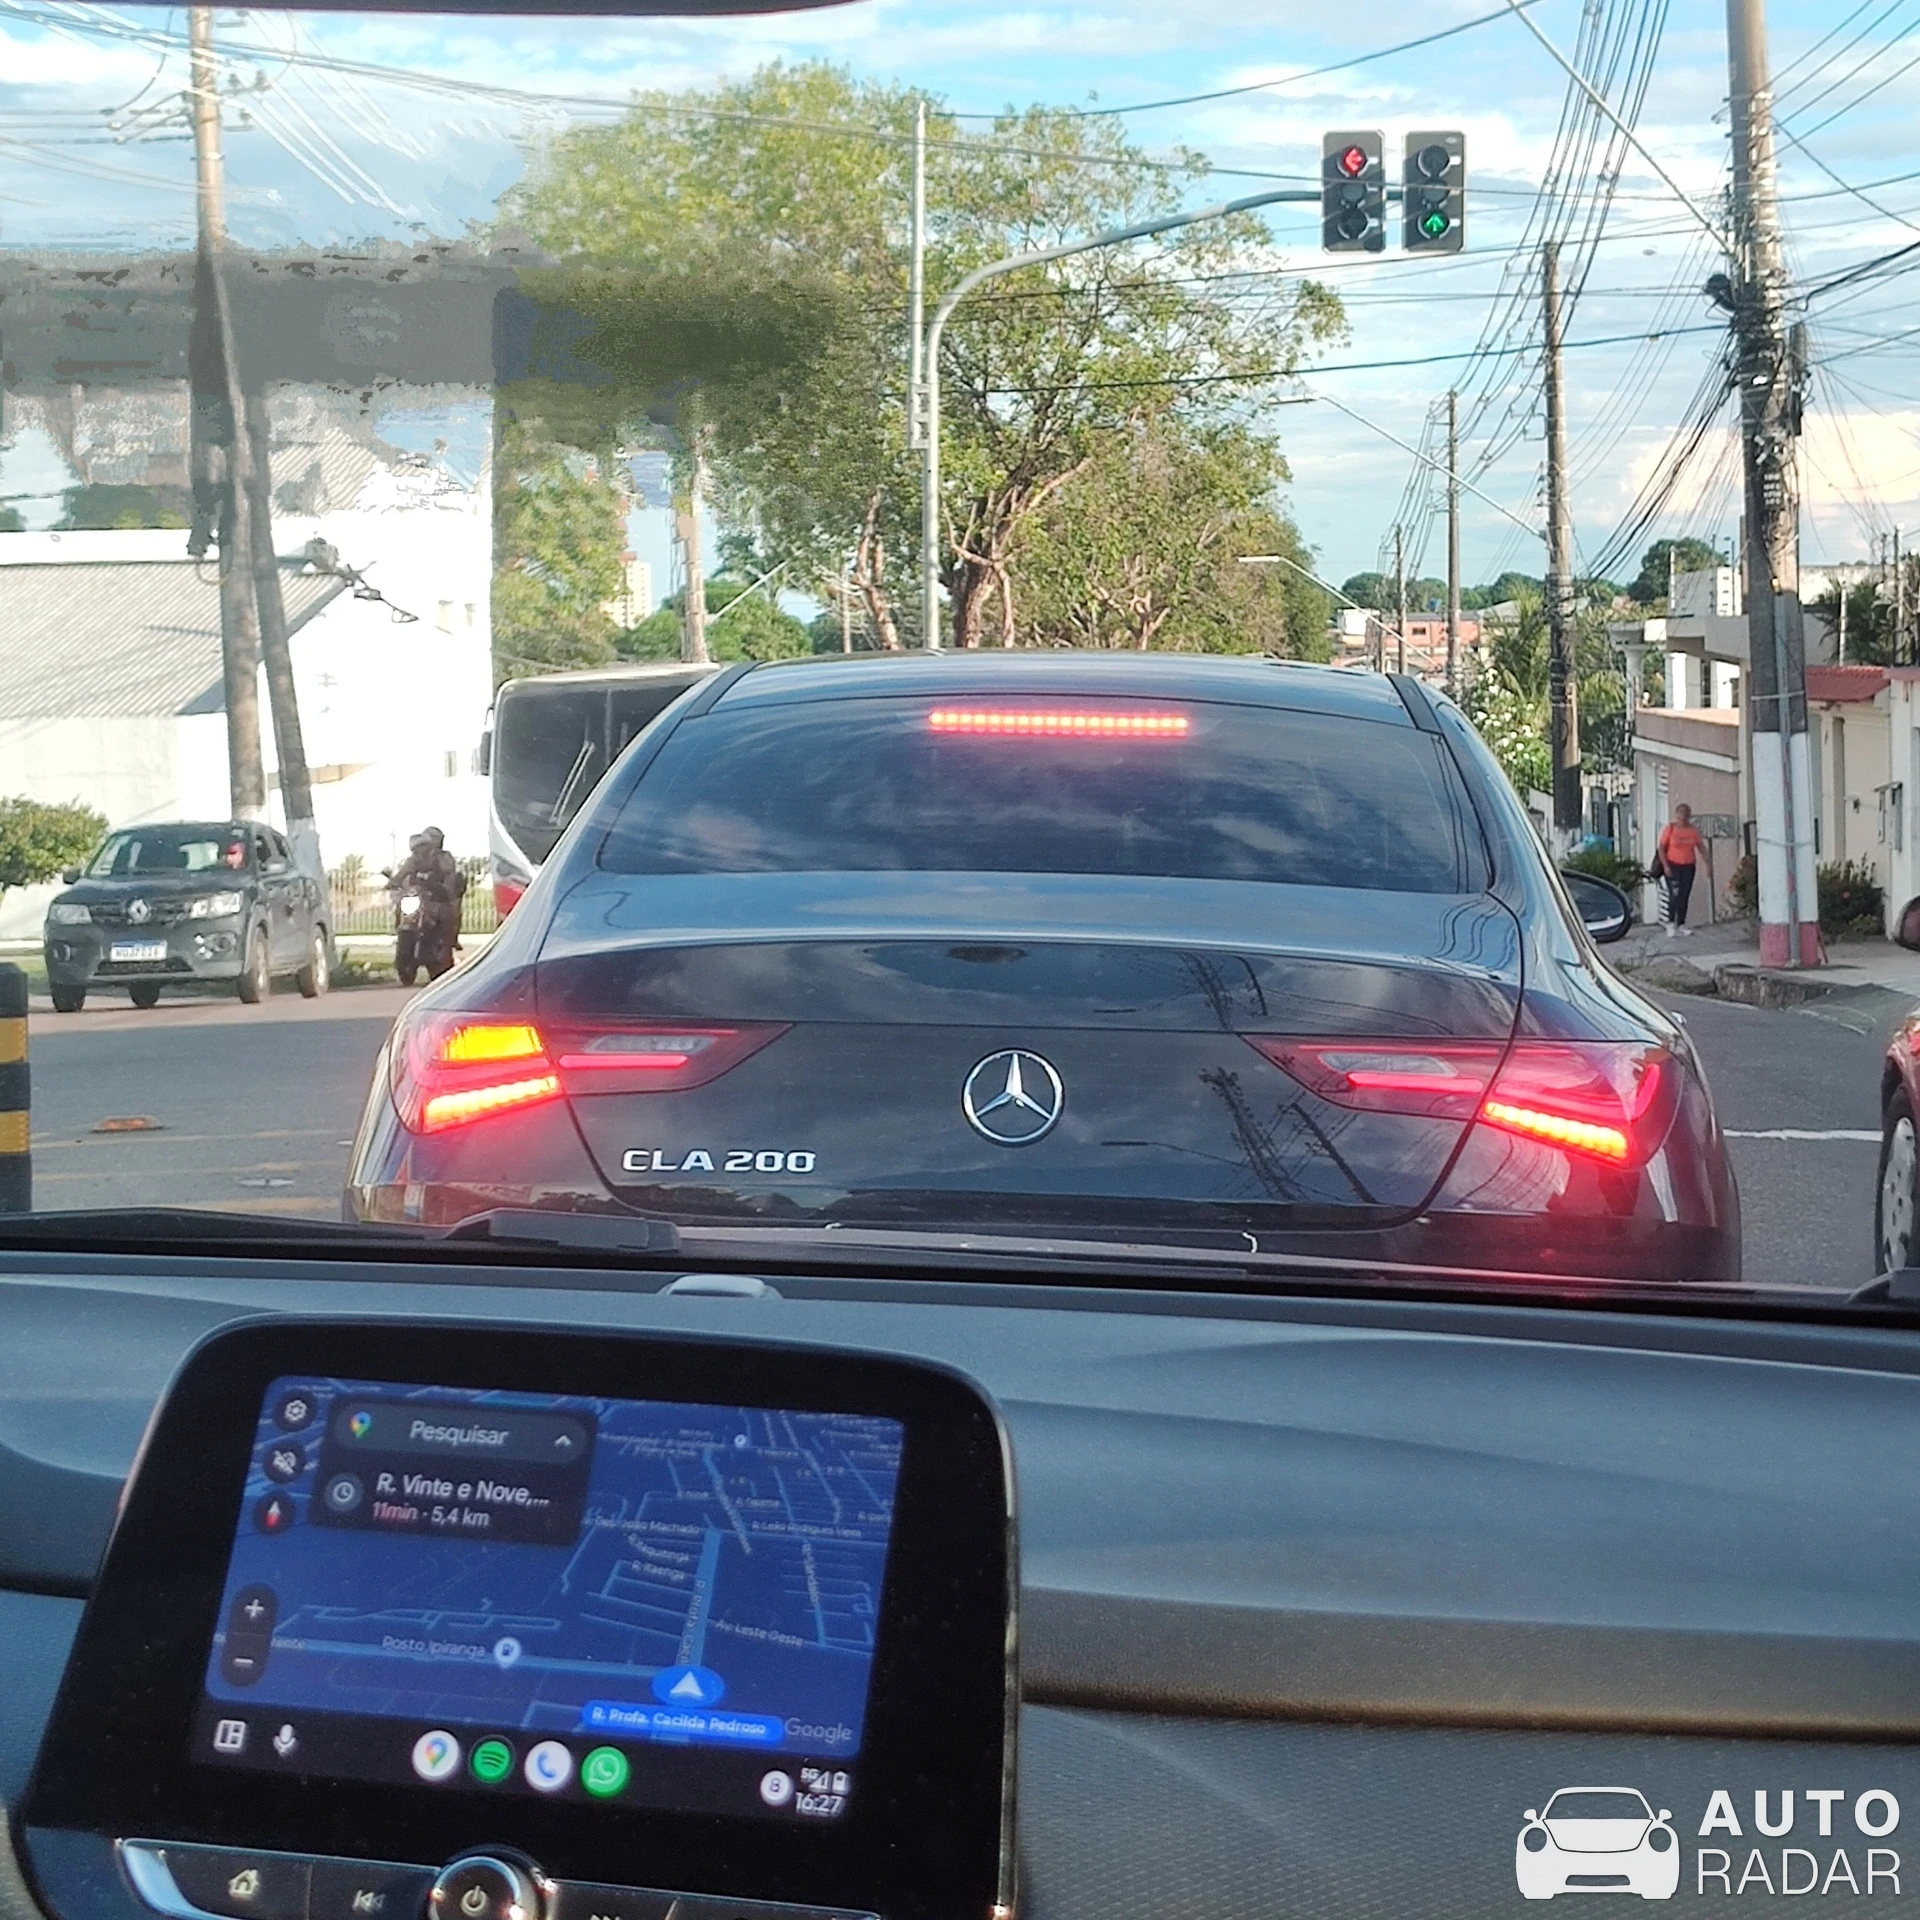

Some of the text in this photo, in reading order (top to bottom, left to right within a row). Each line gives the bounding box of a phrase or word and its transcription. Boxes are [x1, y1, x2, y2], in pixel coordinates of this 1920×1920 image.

[622, 1149, 817, 1173] CLA 200
[410, 1419, 510, 1446] Pesquisar
[376, 1472, 397, 1493] R.
[403, 1474, 453, 1497] Vinte
[457, 1482, 472, 1499] e
[372, 1501, 490, 1527] 11min 5,4 km
[382, 1635, 426, 1652] Posto
[592, 1707, 605, 1720] R.
[653, 1712, 706, 1730] Cacilda
[784, 1717, 853, 1744] Google
[795, 1792, 844, 1816] 16:27
